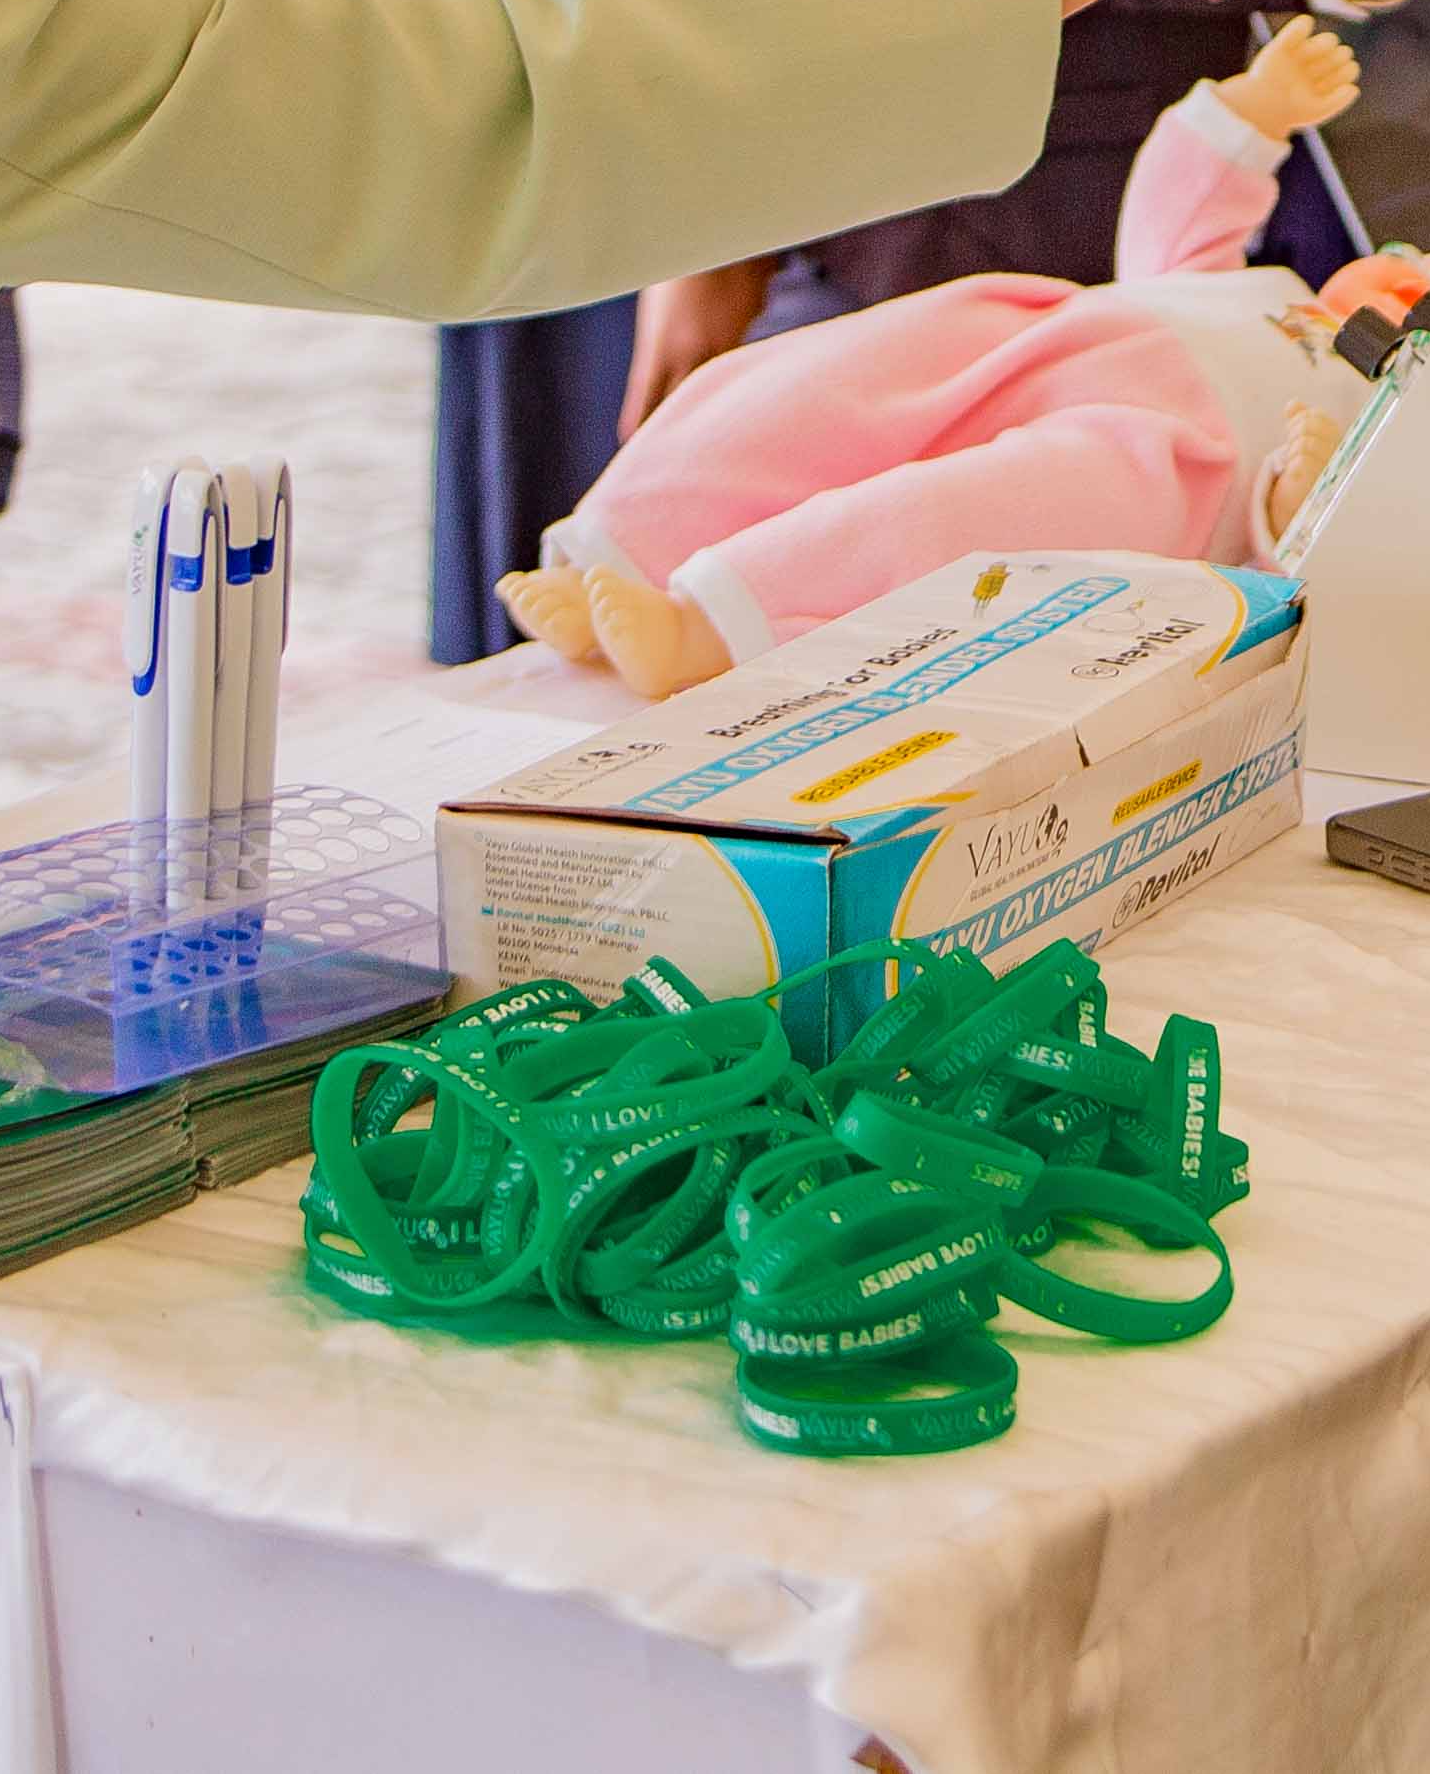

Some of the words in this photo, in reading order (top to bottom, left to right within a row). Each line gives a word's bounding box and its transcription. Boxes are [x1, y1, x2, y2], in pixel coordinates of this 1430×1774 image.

[865, 626, 959, 668] Babies
[1096, 617, 1207, 667] Revital
[722, 702, 874, 770] OXYGEN
[992, 577, 1127, 644] SYSTEM
[510, 841, 544, 855] Global
[545, 846, 580, 859] Health
[540, 857, 559, 868] and
[967, 816, 1042, 877] VAYU
[999, 848, 1113, 939] OXYGEN
[1112, 779, 1230, 876] BLENDER
[485, 876, 514, 888] under
[520, 868, 576, 884] Healthcare
[1134, 832, 1222, 914] Revital
[510, 889, 544, 904] Global
[545, 894, 580, 909] Health
[536, 912, 596, 929] Healthcare
[497, 950, 532, 964] KENYA
[604, 1101, 668, 1132] LOVE
[1181, 1082, 1208, 1179] BABIES!
[937, 1231, 988, 1265] LOVE
[858, 1251, 938, 1298] BABIES!
[766, 1330, 831, 1355] LOVE
[838, 1312, 923, 1351] BABIES!
